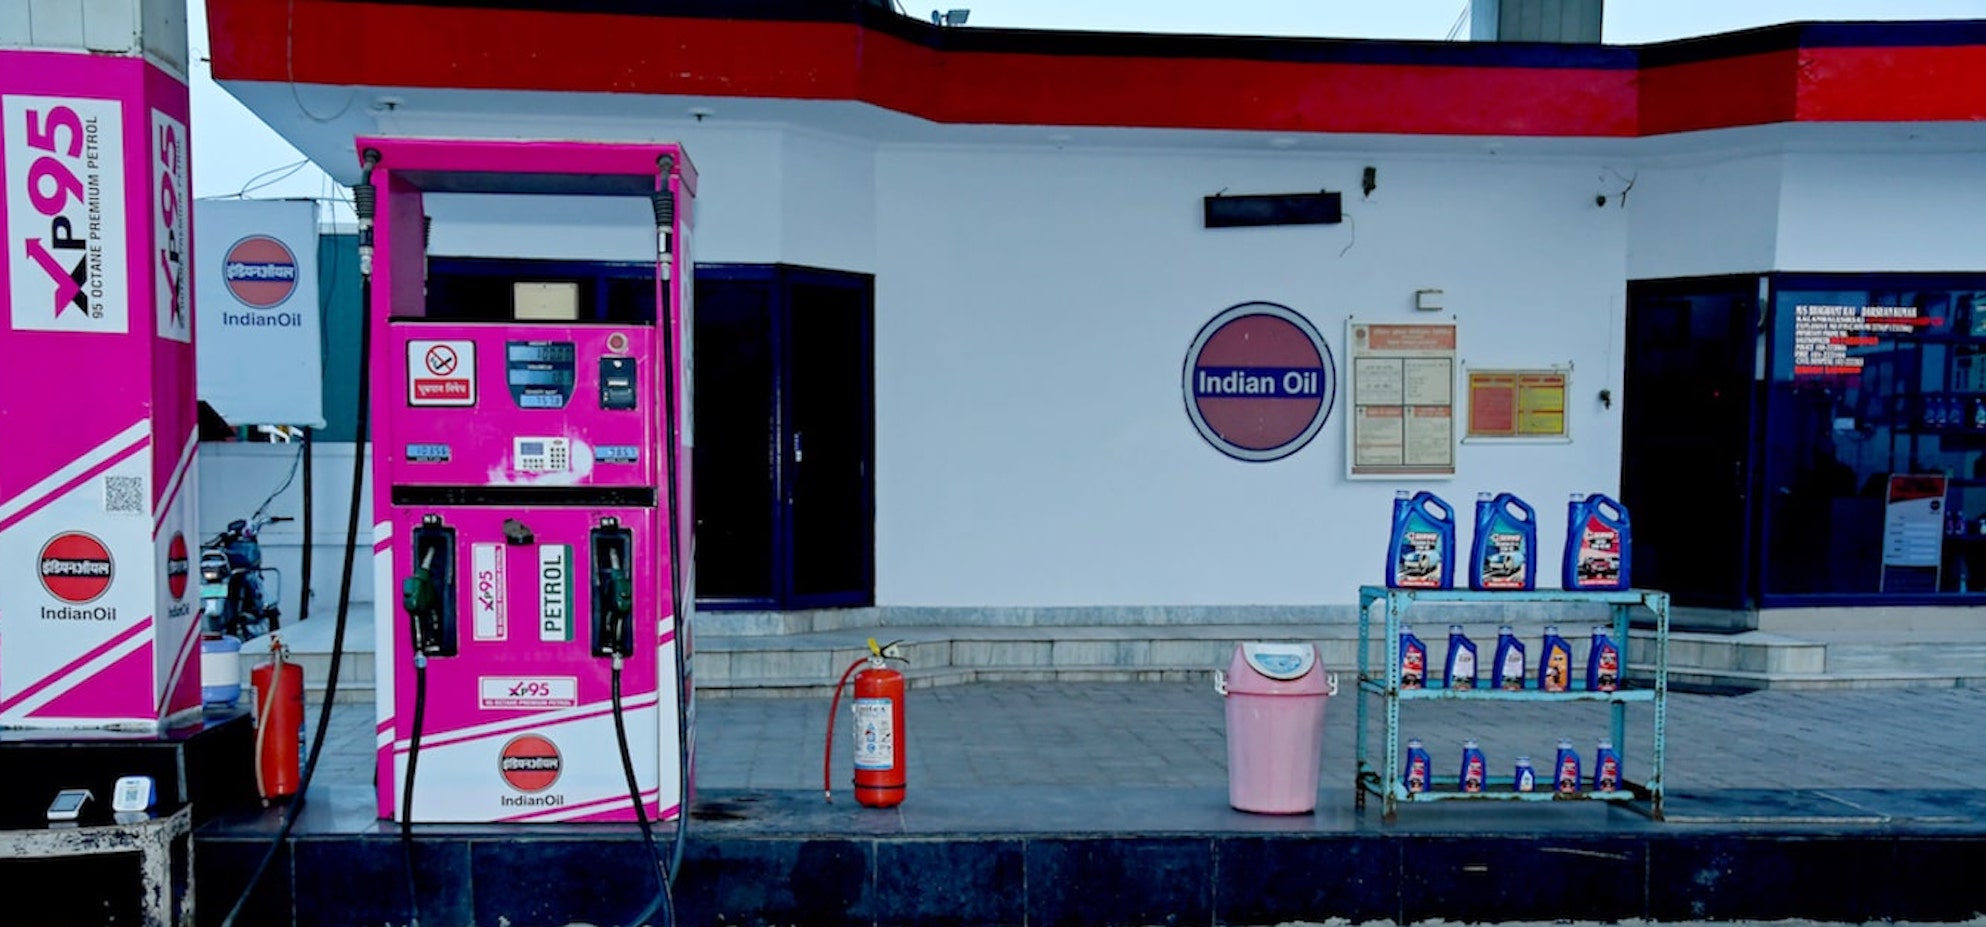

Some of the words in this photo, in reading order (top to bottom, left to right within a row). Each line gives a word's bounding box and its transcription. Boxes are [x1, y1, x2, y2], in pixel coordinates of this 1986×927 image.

[85, 115, 99, 170] PETROL
[87, 173, 102, 241] PREMIUM
[90, 244, 104, 299] OCTANE
[92, 302, 104, 319] 95
[223, 311, 302, 327] IndianOil
[1199, 370, 1276, 394] Indian
[1282, 371, 1318, 395] Oil
[543, 554, 563, 632] PETROL
[41, 605, 117, 621] IndianOil
[508, 681, 550, 697] XP95
[501, 794, 564, 807] IndianOil
